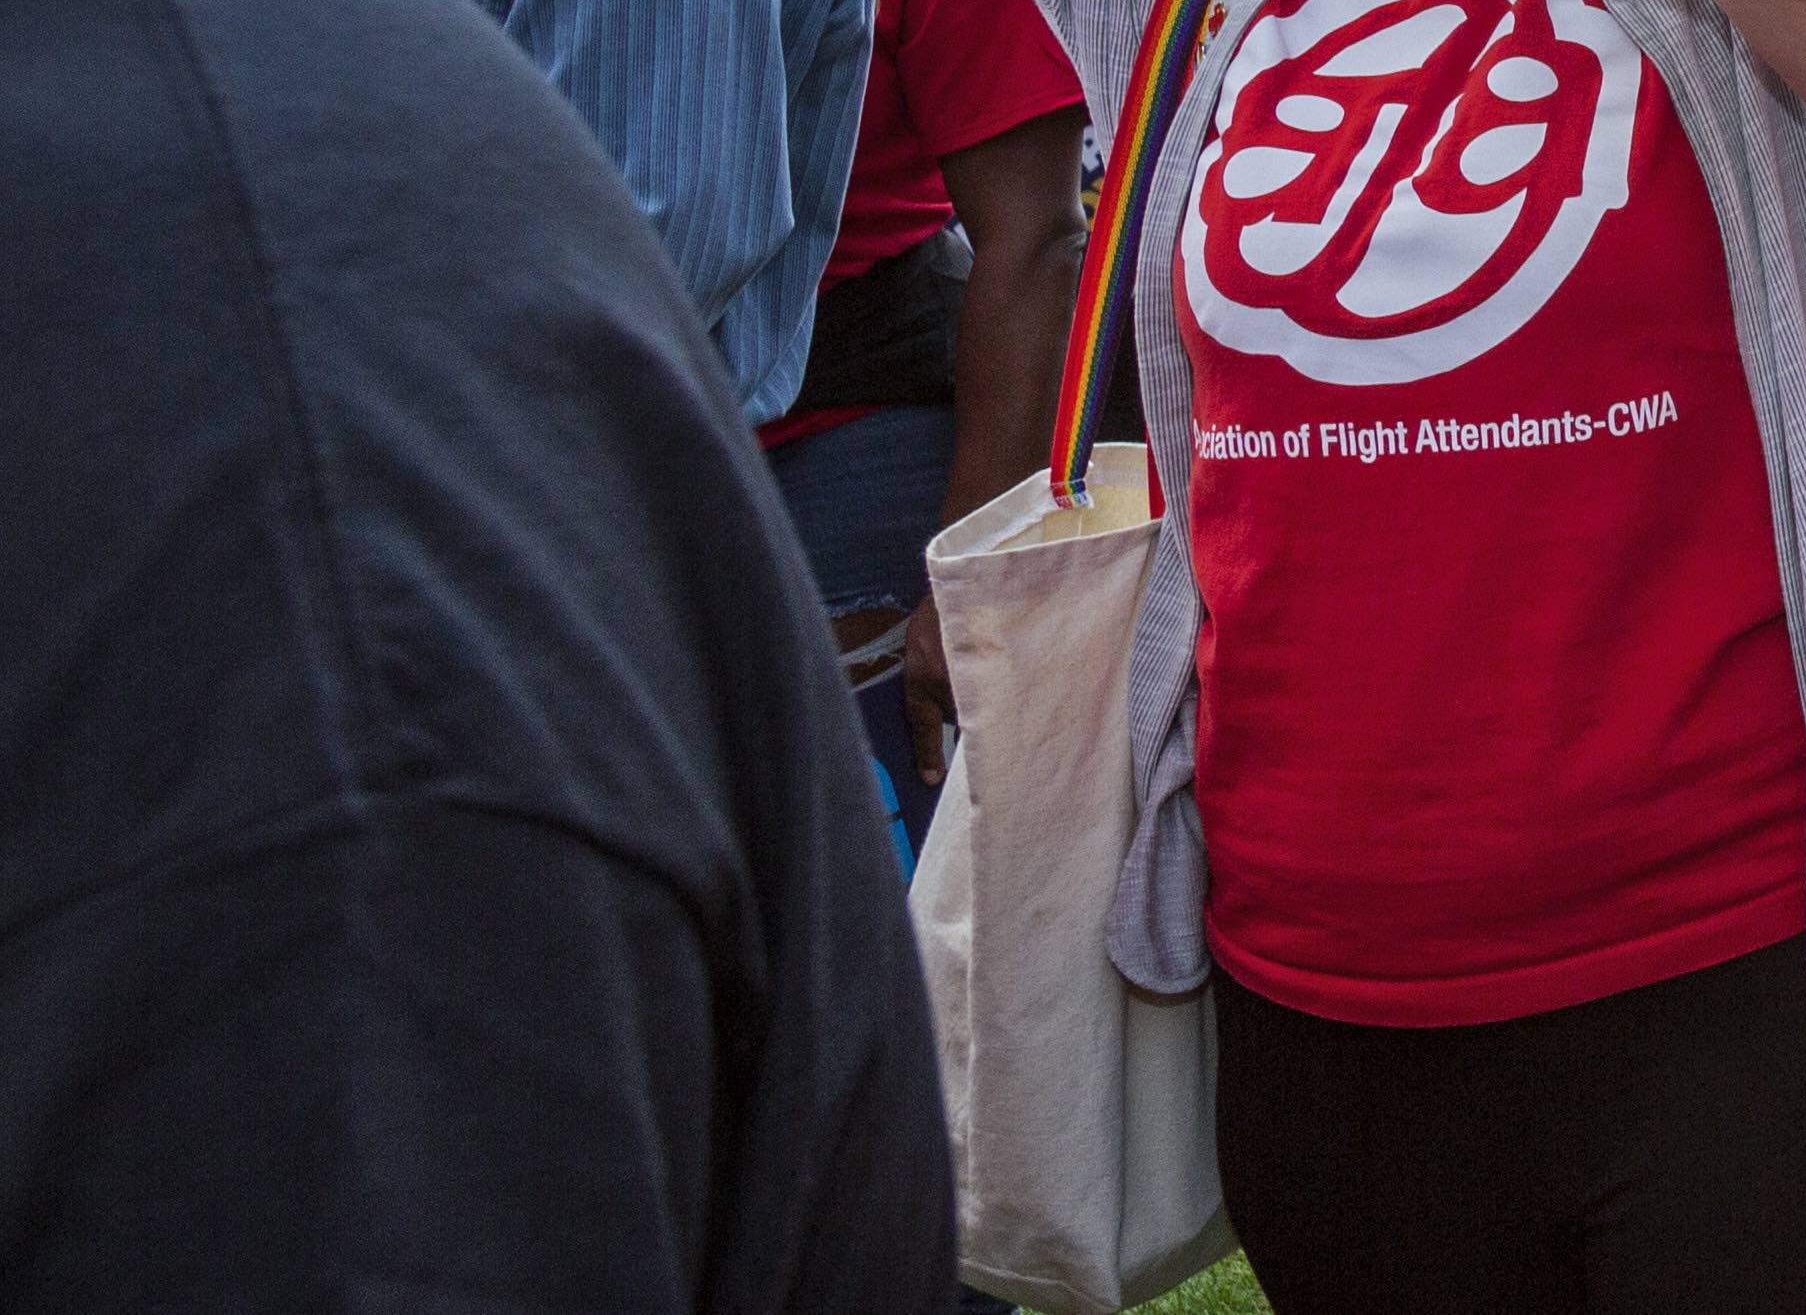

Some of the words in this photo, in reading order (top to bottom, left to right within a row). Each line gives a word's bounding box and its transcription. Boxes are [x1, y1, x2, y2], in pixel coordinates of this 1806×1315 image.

[1283, 423, 1310, 458] of
[1319, 421, 1409, 464] Flight
[1415, 390, 1678, 454] Attendants-CWA
